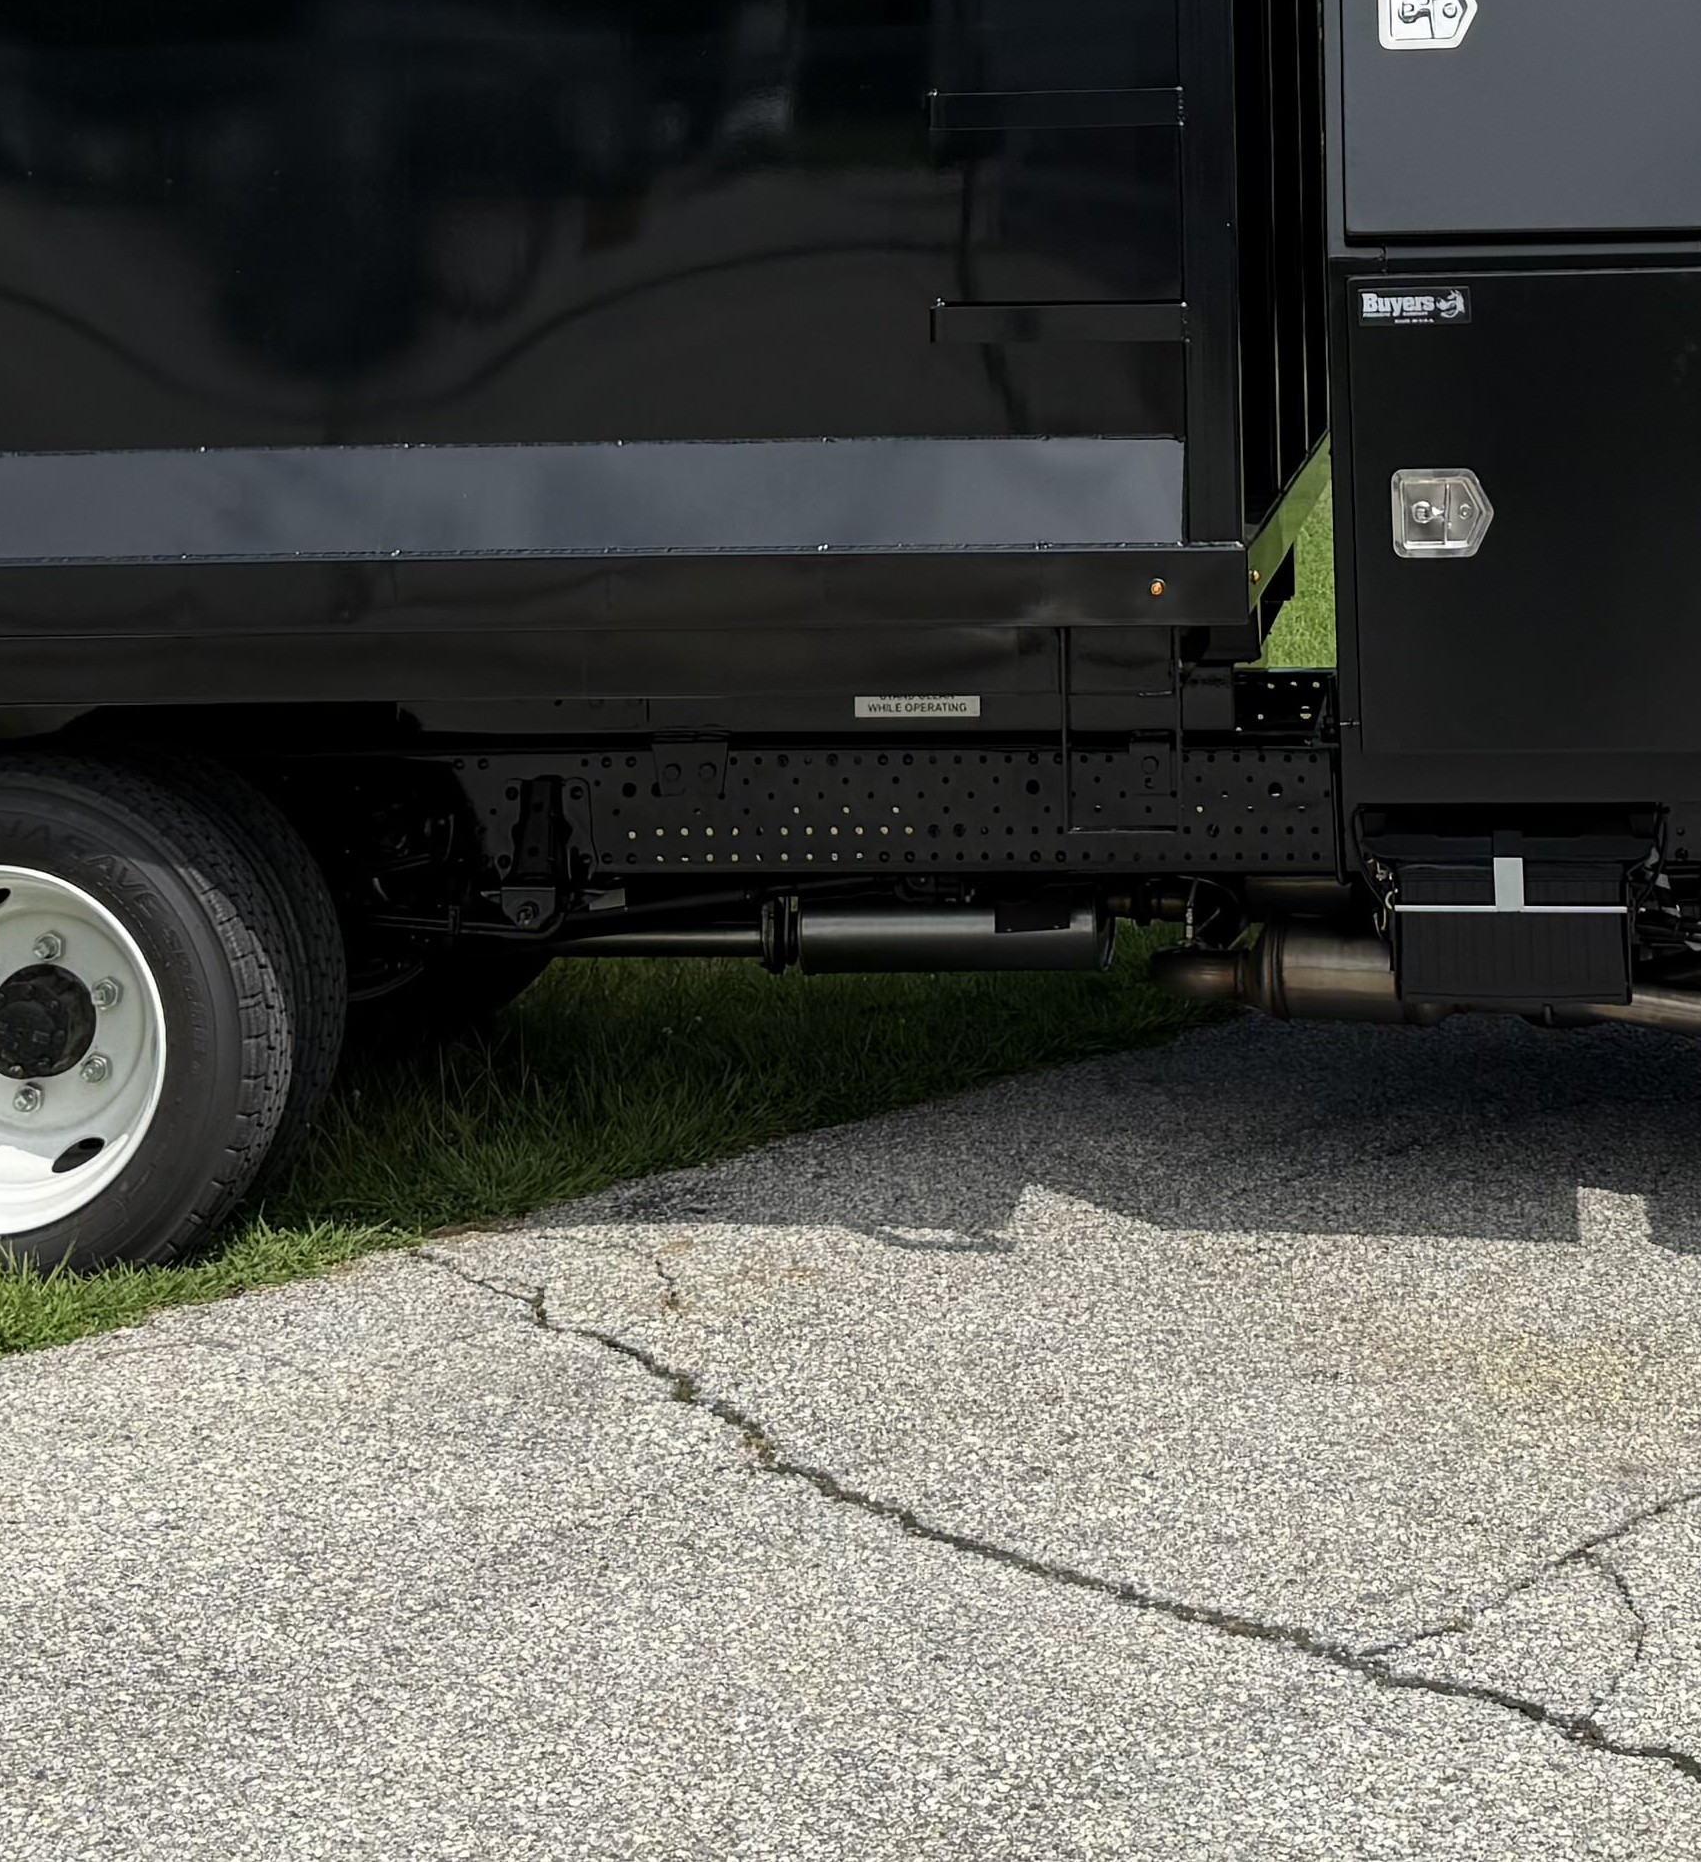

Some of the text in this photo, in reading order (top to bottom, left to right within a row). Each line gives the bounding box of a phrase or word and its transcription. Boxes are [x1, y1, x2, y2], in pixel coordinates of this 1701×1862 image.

[1362, 293, 1434, 317] Buyers
[868, 702, 967, 713] WHILE OPERATING
